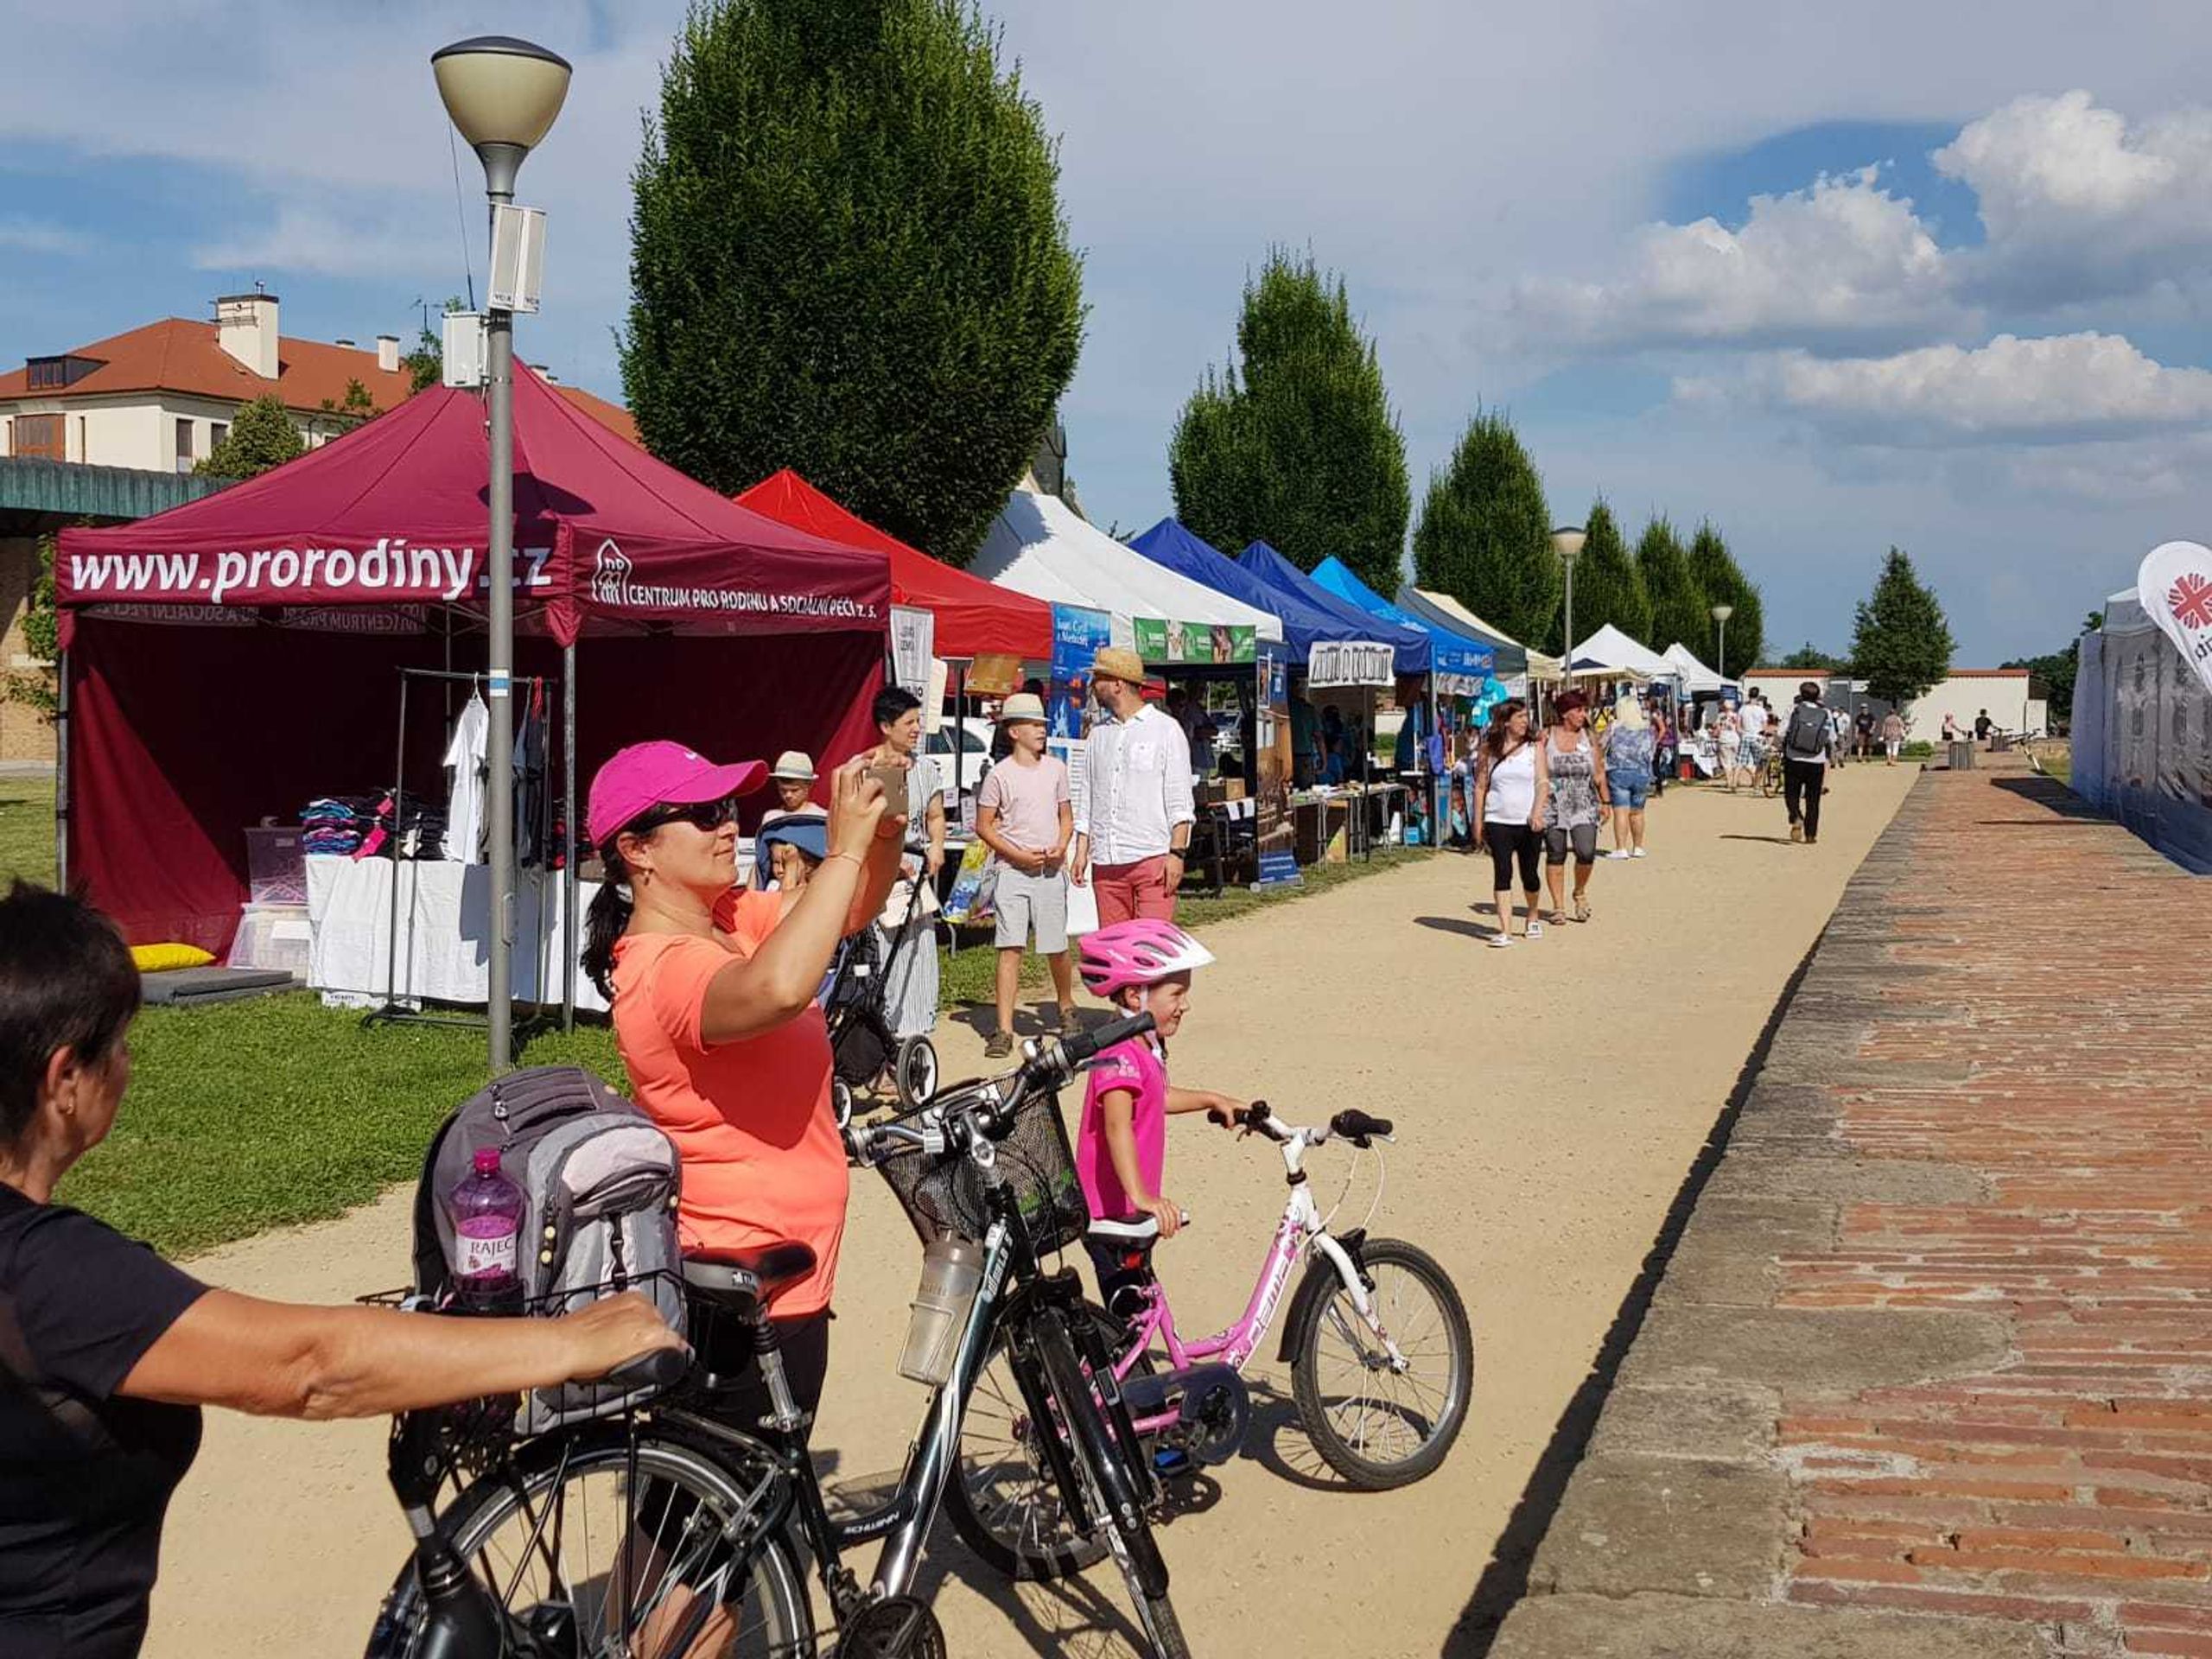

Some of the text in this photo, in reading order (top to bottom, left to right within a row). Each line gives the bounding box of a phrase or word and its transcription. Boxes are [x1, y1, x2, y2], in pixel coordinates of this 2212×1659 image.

[71, 539, 551, 603] www.prorodiny.z
[628, 584, 691, 607] CENTRUM
[692, 589, 719, 608] PRO
[720, 590, 767, 612] RODINU
[770, 594, 779, 613] A
[470, 1236, 513, 1257] RAJEC
[843, 1510, 900, 1535] SCHWINN
